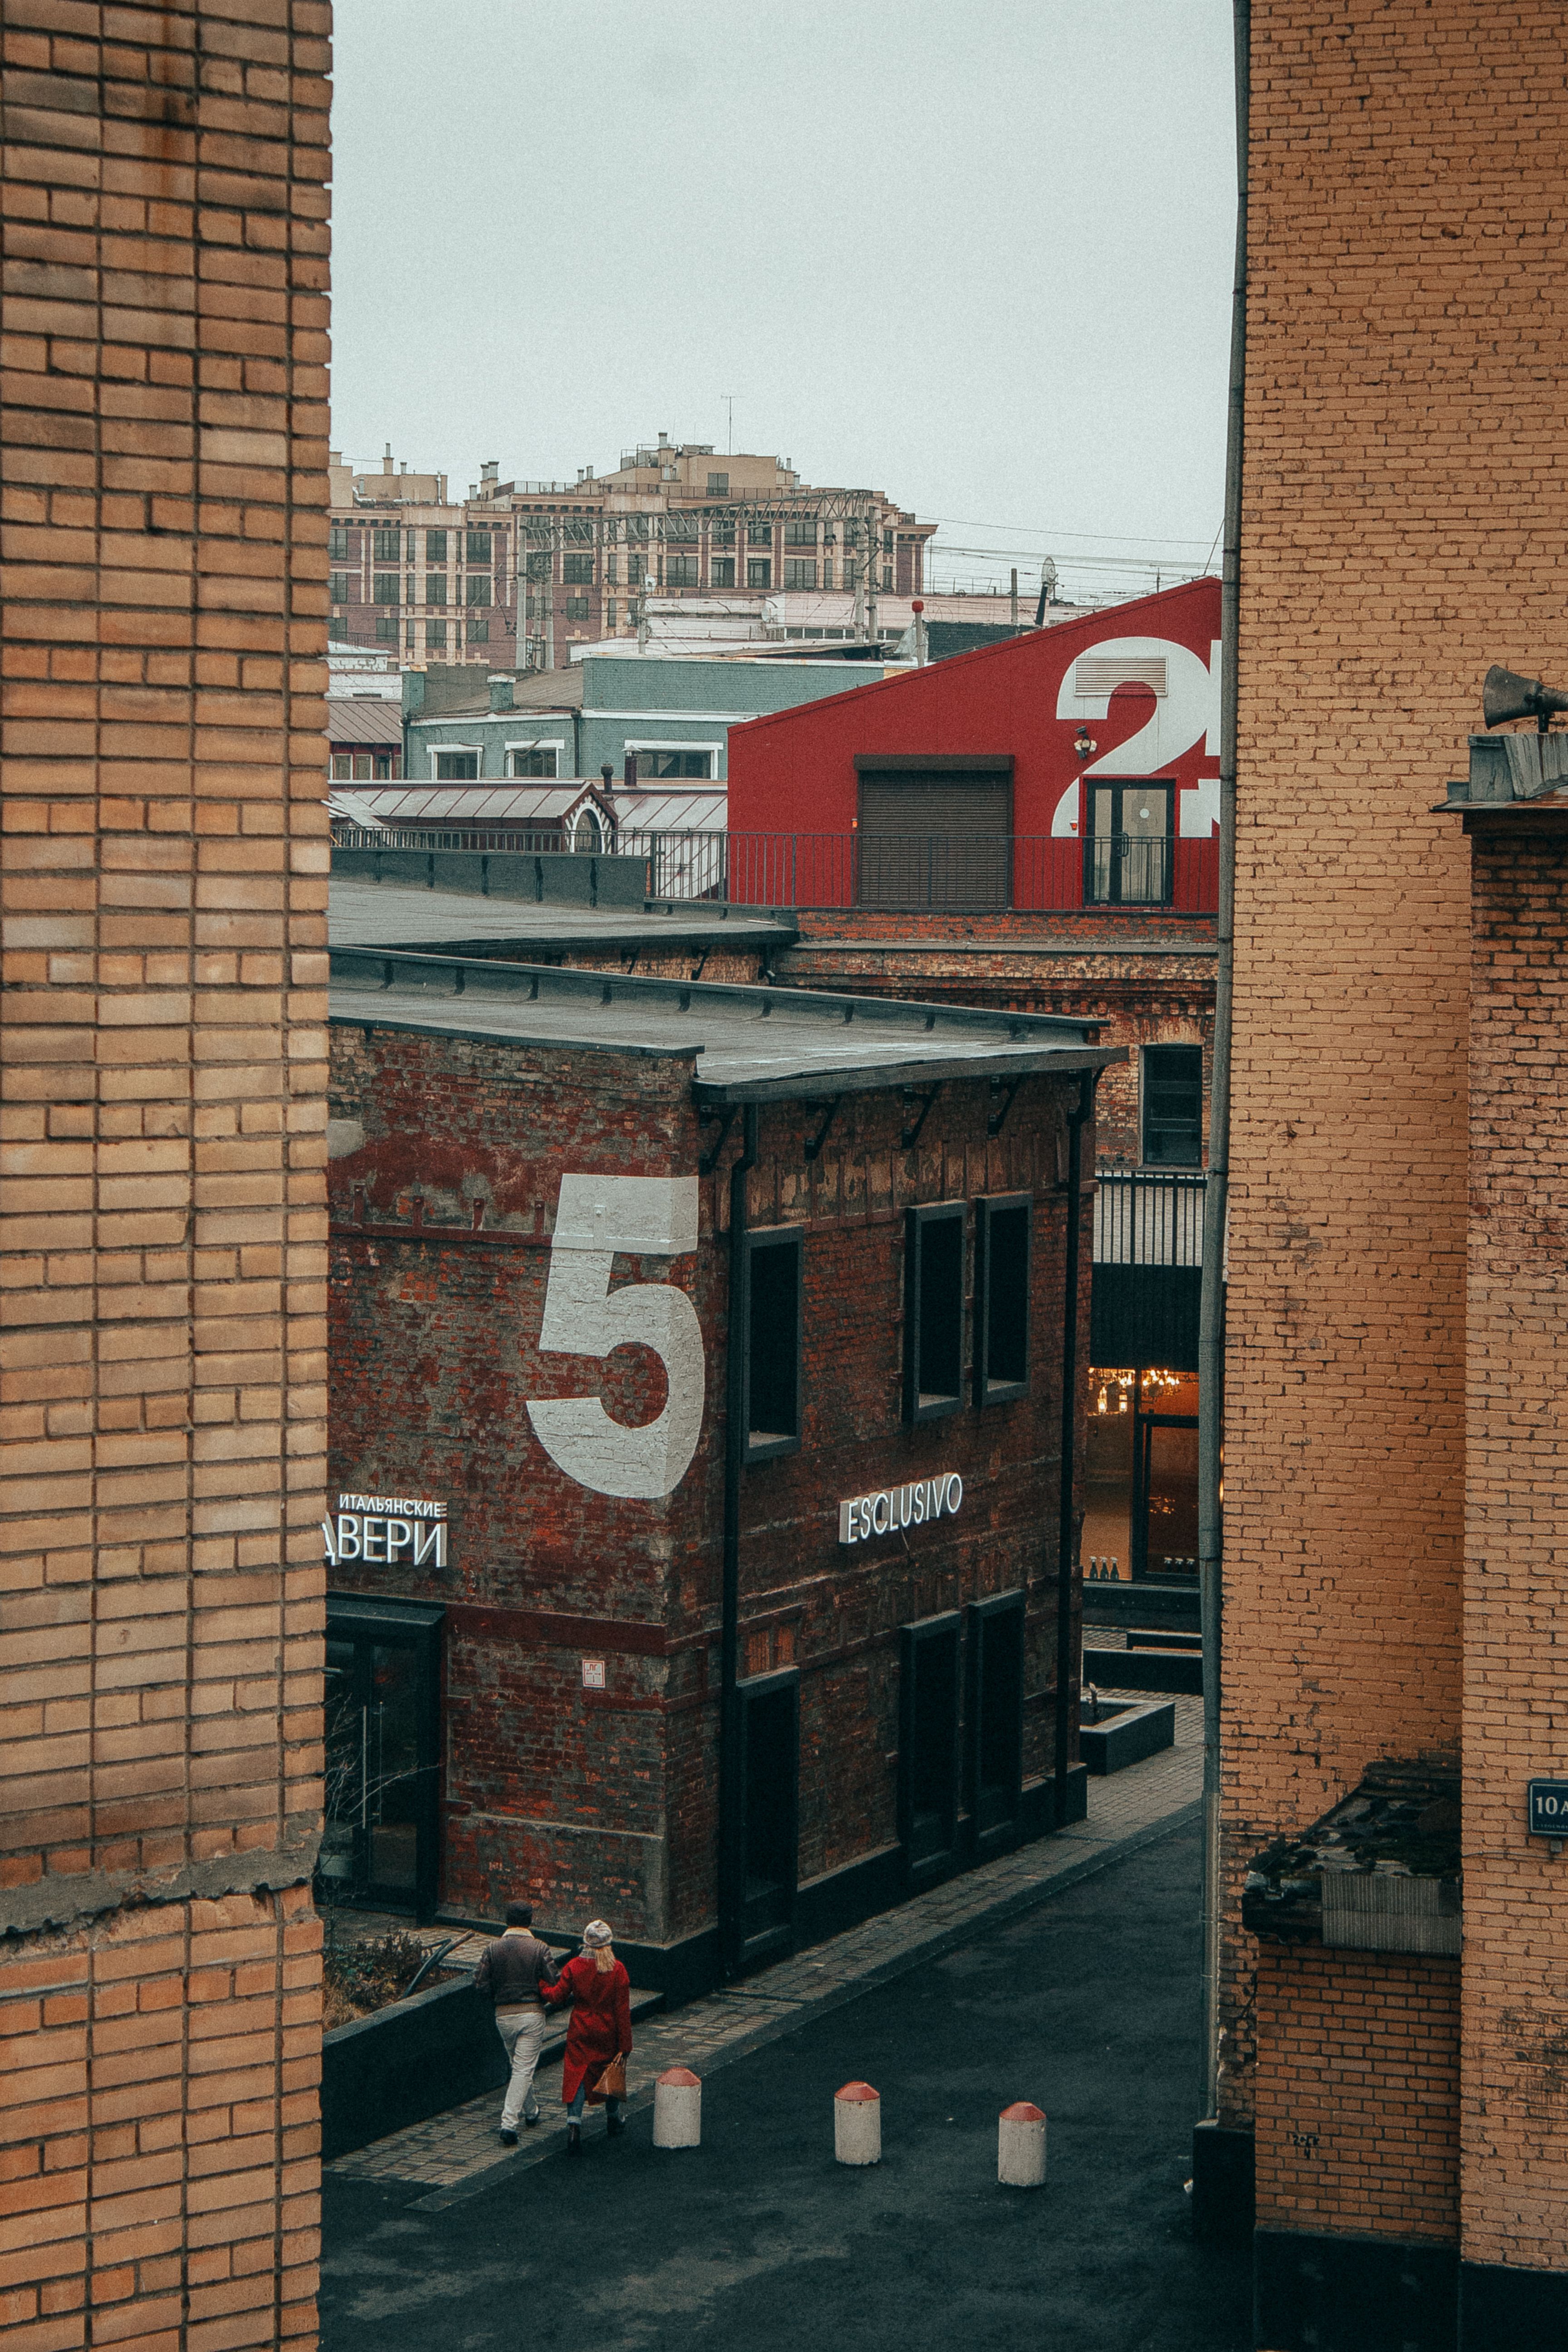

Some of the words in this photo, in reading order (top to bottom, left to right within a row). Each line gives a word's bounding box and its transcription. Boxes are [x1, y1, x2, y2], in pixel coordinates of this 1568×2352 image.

[526, 1173, 705, 1499] 5
[340, 1493, 447, 1518] ИТАЛЬЯНСКИЕ
[840, 1473, 962, 1544] ESCLUSIVO
